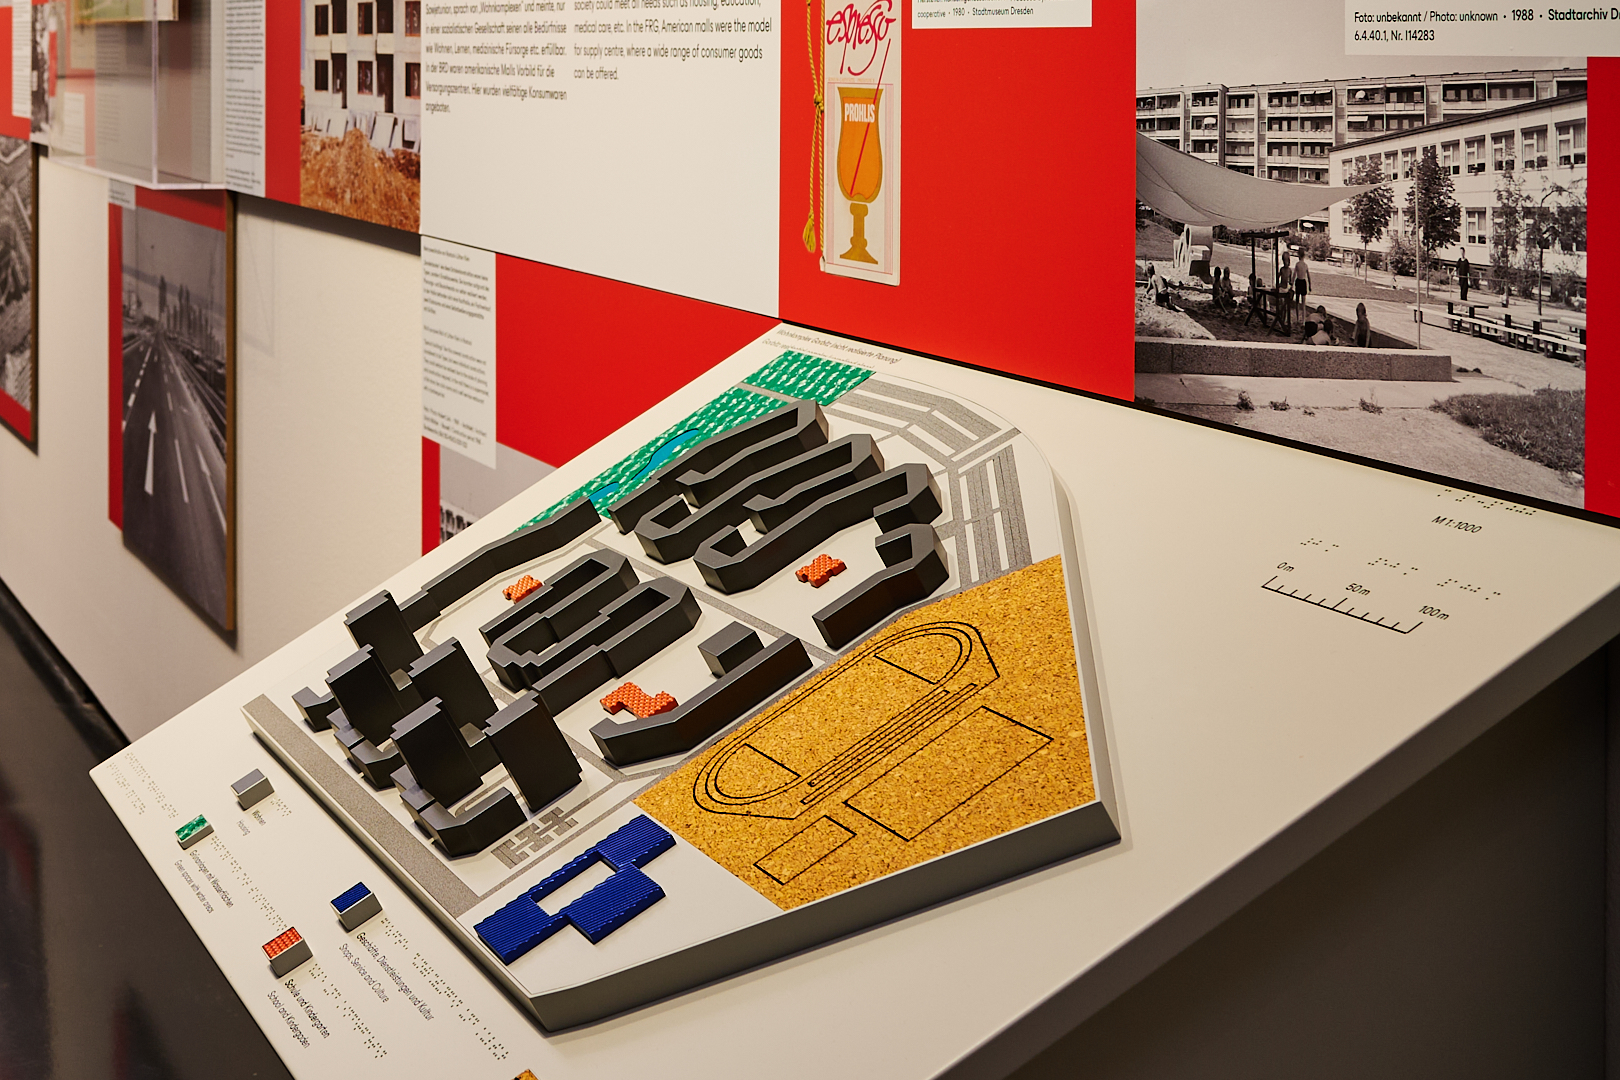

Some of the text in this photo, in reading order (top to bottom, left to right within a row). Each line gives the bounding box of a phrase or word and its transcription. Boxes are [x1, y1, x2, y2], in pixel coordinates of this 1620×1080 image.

[1355, 12, 1375, 23] Foto:
[1377, 12, 1422, 23] unbekannt
[1430, 11, 1457, 22] Photo:
[1460, 11, 1498, 22] unknown
[1512, 9, 1534, 21] 1988
[1548, 8, 1608, 21] Stadtarchiv
[1355, 30, 1389, 42] 6.4.40.1,
[1391, 30, 1403, 41] Nr.
[844, 103, 876, 123] PROHLIS
[1276, 562, 1295, 573] 0m
[1346, 583, 1371, 597] 50m
[1418, 605, 1450, 621] 100m
